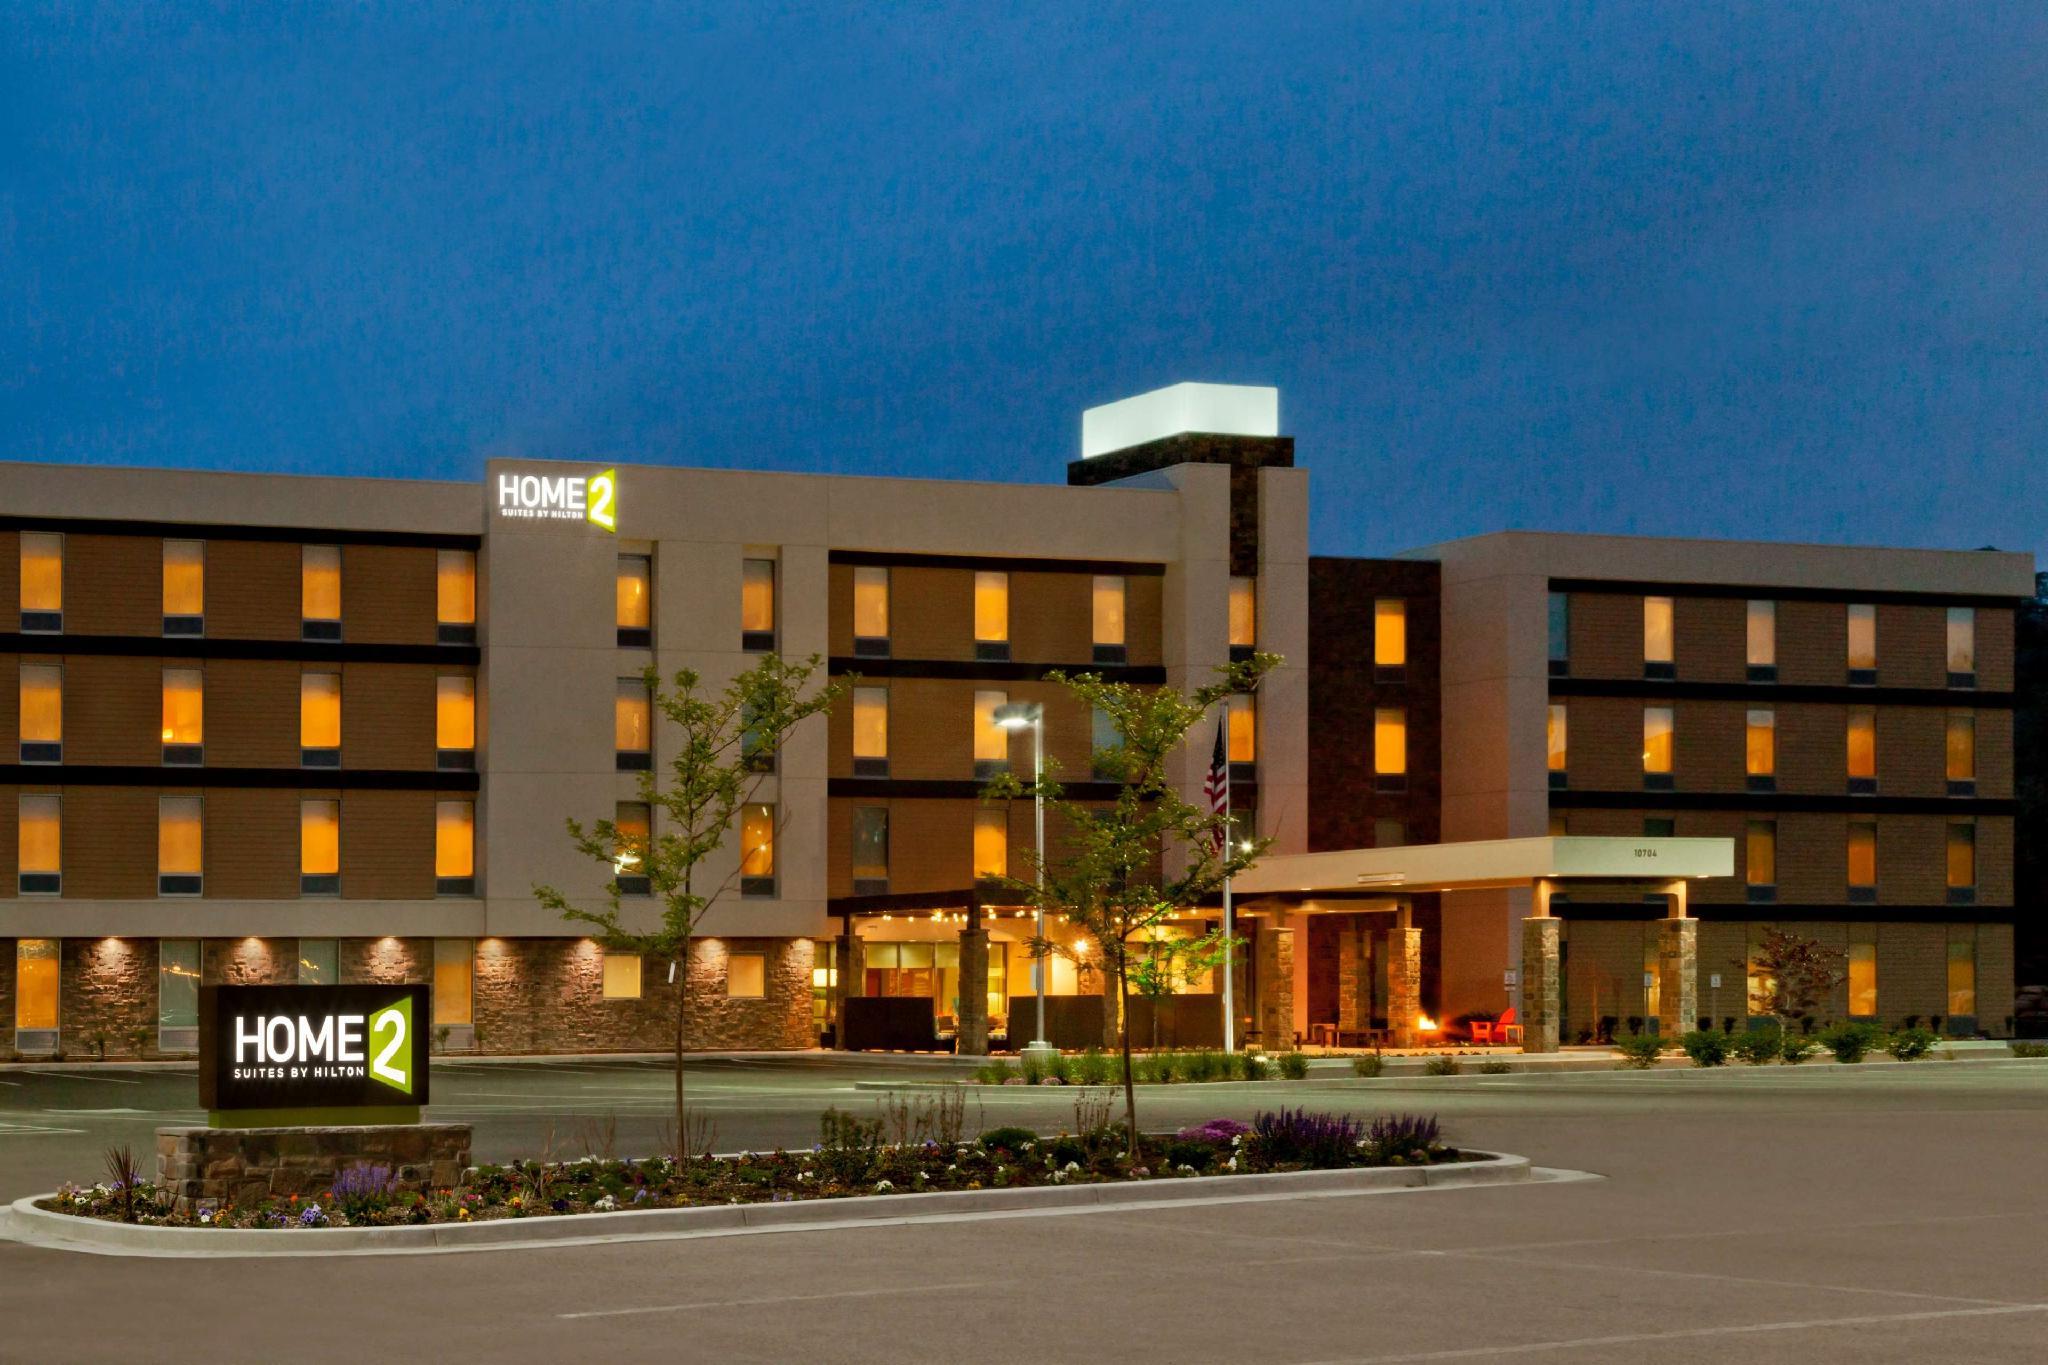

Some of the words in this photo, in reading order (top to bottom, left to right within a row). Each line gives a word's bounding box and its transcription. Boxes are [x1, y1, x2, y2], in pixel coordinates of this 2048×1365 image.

[499, 474, 586, 509] HOME
[590, 476, 614, 527] 2
[501, 508, 534, 517] SUITES
[537, 509, 549, 518] BY
[551, 510, 584, 519] HILTON
[1634, 848, 1657, 857] 10704
[235, 1015, 364, 1063] HOME
[373, 1009, 406, 1085] 2
[234, 1067, 285, 1079] SUITES
[291, 1067, 308, 1078] BY
[314, 1066, 364, 1078] HILTON
